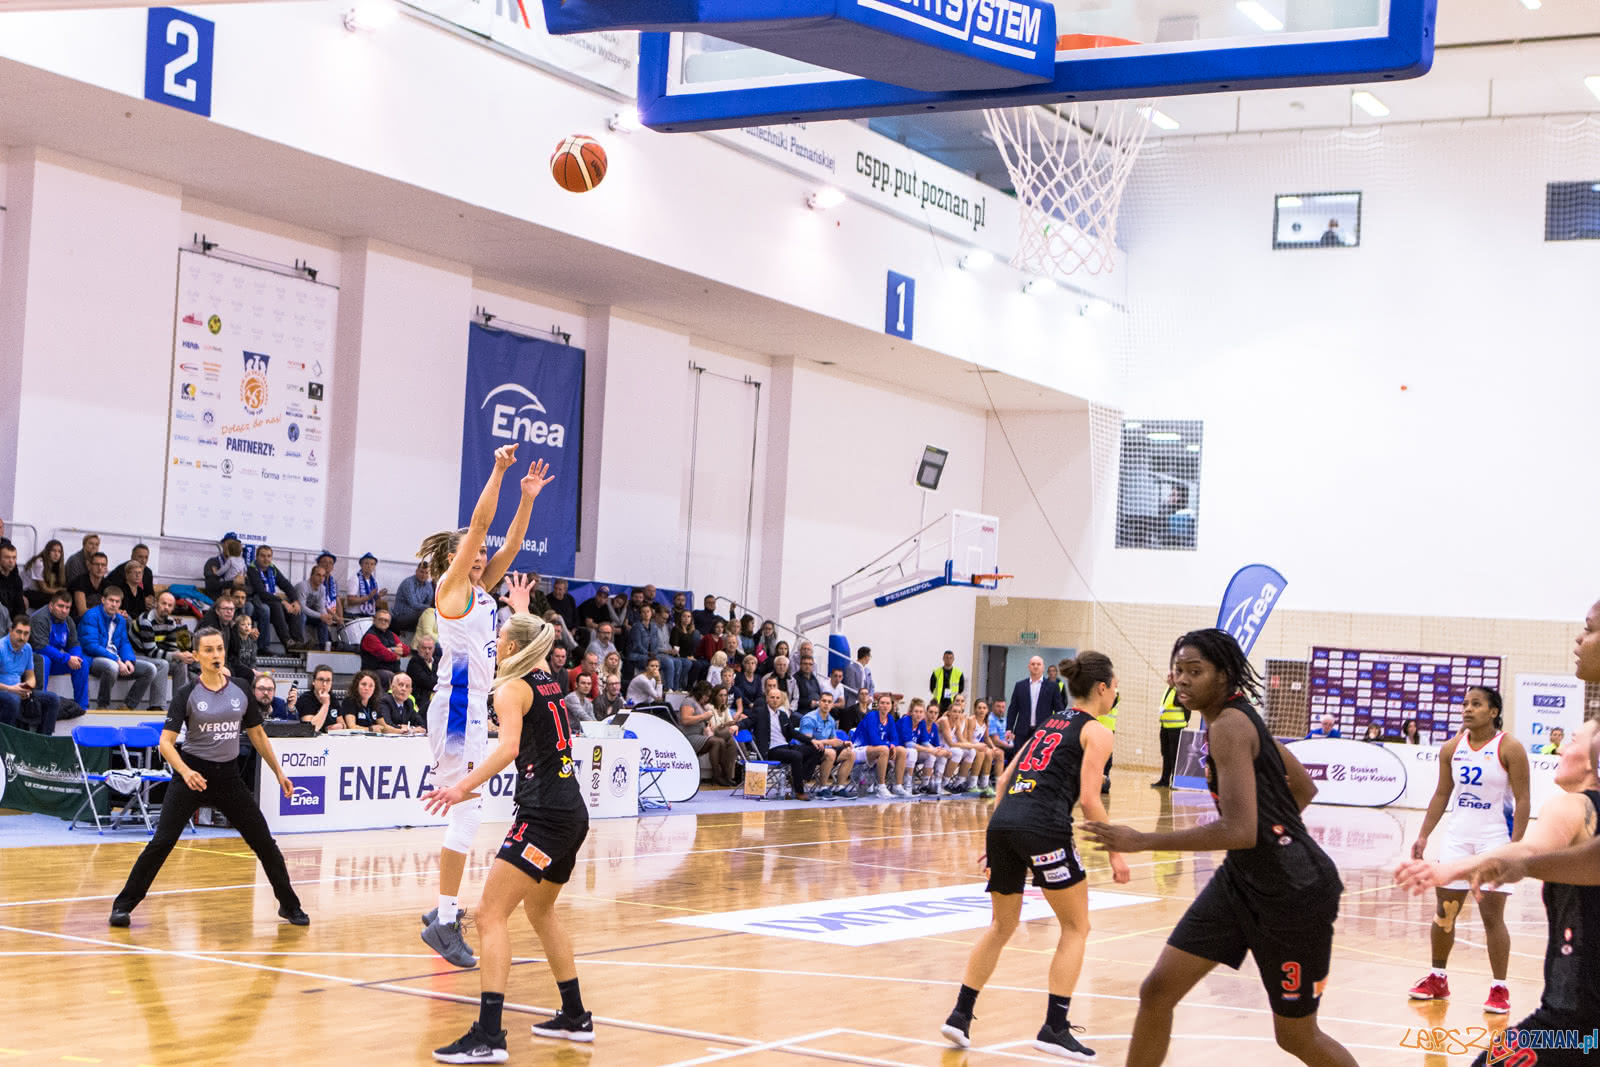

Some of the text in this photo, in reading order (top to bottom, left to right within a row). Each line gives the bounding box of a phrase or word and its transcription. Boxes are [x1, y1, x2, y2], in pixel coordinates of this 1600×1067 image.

[163, 19, 199, 102] 2
[855, 150, 986, 231] cspp.put.poznan.pl
[896, 281, 906, 333] 1
[492, 404, 565, 448] Enea
[226, 437, 276, 457] PARTNERZY:
[885, 582, 932, 602] PESMENPOL
[1234, 583, 1278, 654] Enea
[654, 749, 677, 760] Basket
[1018, 729, 1063, 772] 13
[671, 761, 693, 770] Kobiet
[1350, 765, 1378, 773] Basket
[339, 765, 411, 801] ENEA
[1350, 774, 1397, 783] Liga Kobiet
[1460, 766, 1482, 786] 32
[290, 793, 320, 807] Enea
[1458, 799, 1491, 810] Enea
[1281, 961, 1302, 992] 3
